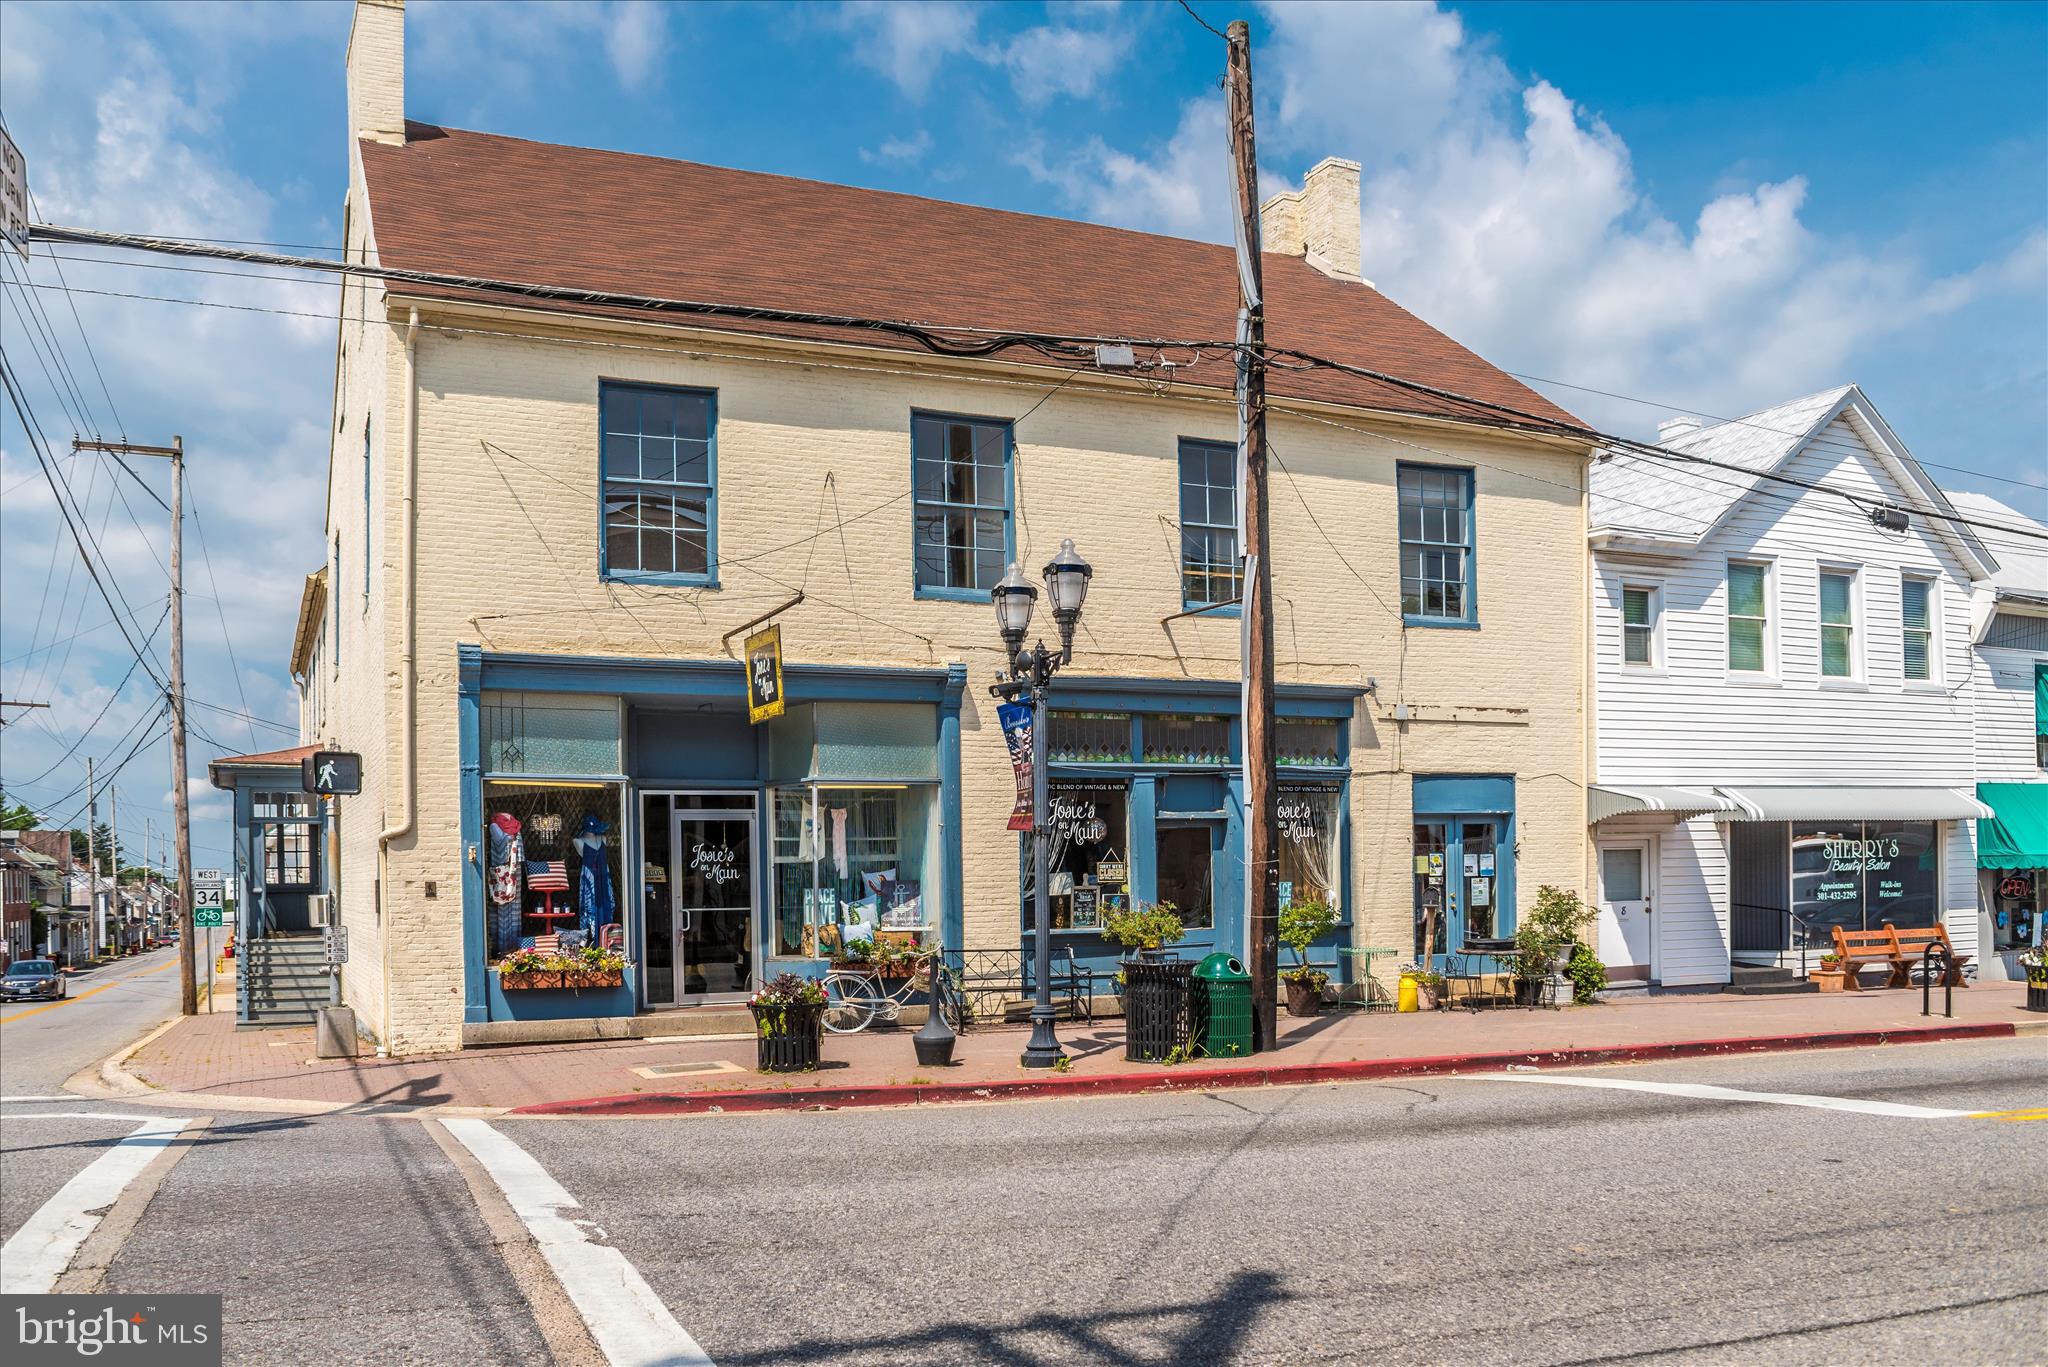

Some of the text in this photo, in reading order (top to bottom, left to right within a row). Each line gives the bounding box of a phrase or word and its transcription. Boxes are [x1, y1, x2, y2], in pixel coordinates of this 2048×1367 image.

[3, 143, 16, 174] NO
[10, 212, 26, 245] RED
[1048, 796, 1096, 826] Josie's
[1276, 797, 1310, 818] osie's
[1058, 821, 1069, 830] on
[1064, 820, 1102, 846] Main
[1277, 821, 1288, 829] on
[1283, 820, 1317, 843] Main
[690, 843, 734, 868] Josie's
[1823, 838, 1899, 859] SHERRY'S
[706, 863, 740, 884] Main
[1099, 868, 1124, 877] CLOSED
[1832, 859, 1892, 875] Beauty Salon
[1817, 891, 1857, 900] 301-432-2295
[1819, 883, 1854, 891] Appointments
[1879, 890, 1904, 898] Welcome!
[2001, 878, 2030, 896] OPEN
[197, 891, 220, 905] 34
